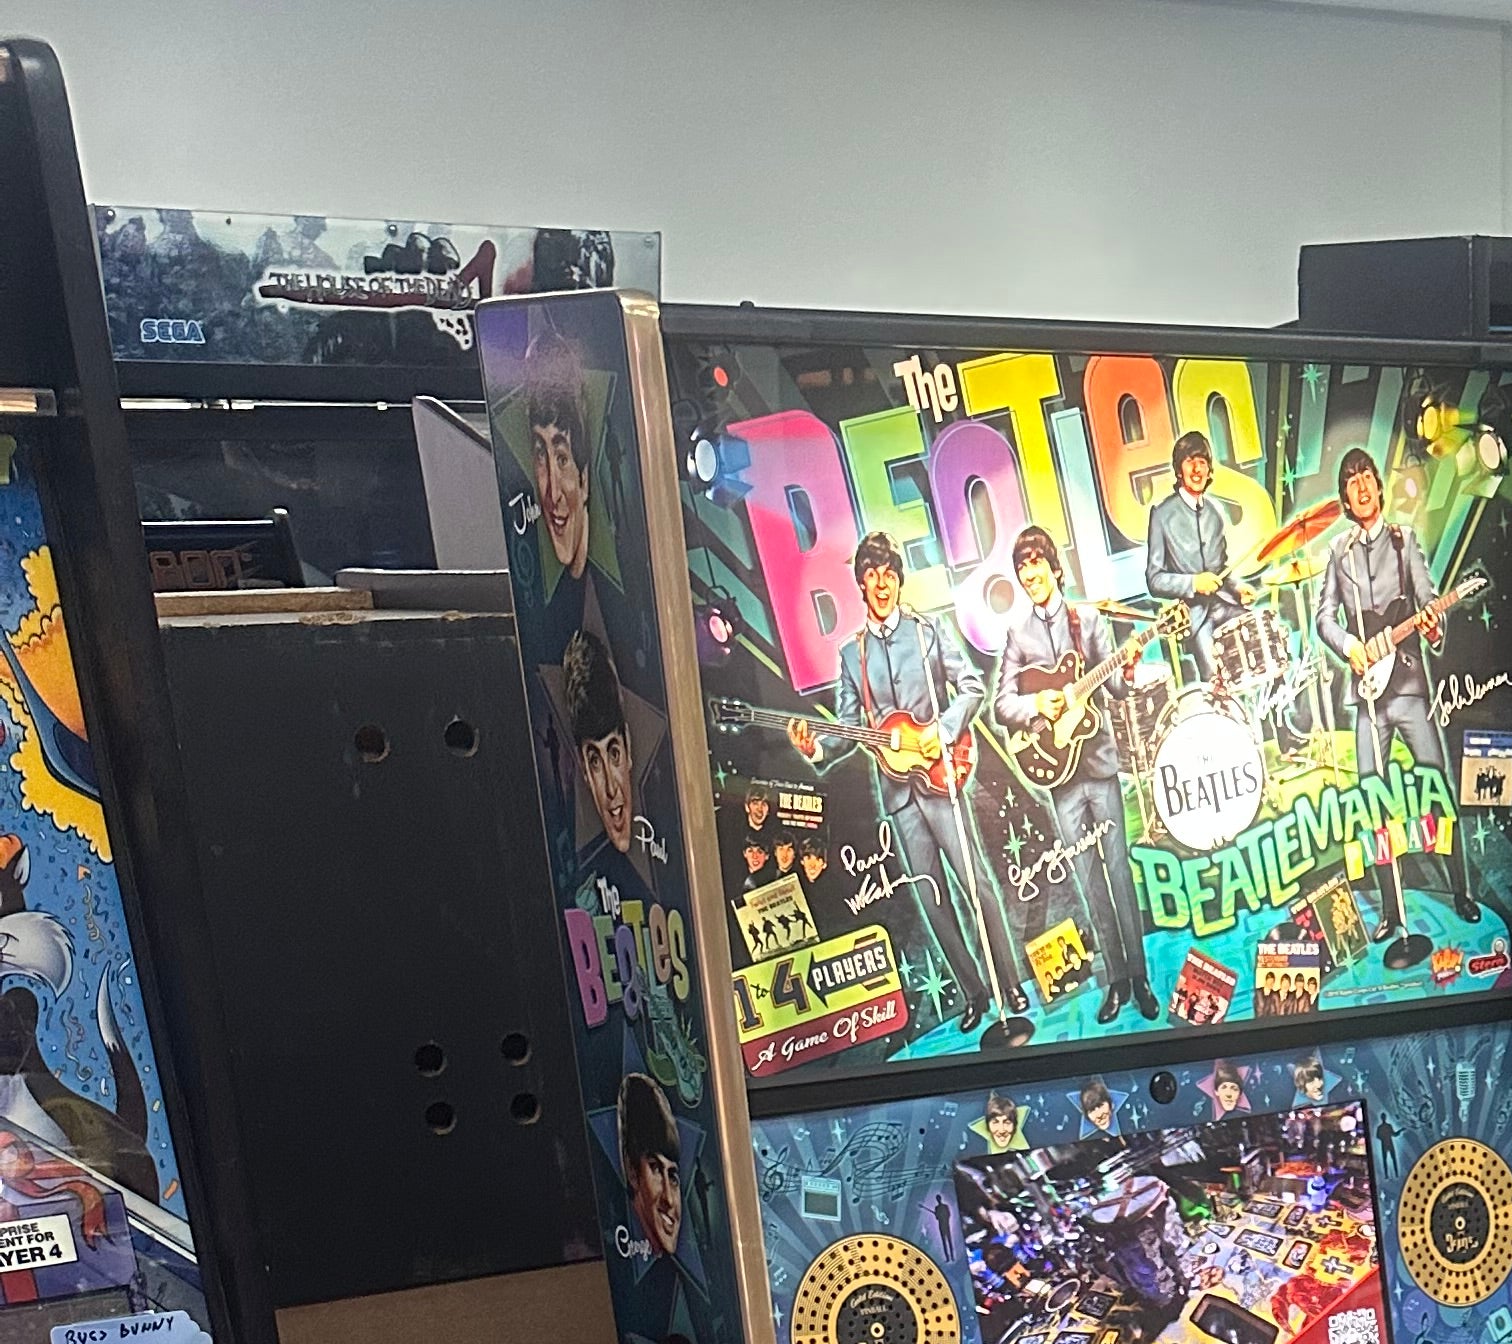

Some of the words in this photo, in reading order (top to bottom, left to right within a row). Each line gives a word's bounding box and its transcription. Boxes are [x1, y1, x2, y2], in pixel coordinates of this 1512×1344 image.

[270, 272, 303, 291] THE
[305, 272, 367, 302] HOUSE
[368, 276, 396, 297] OF
[141, 318, 205, 344] SEGA
[895, 354, 958, 424] The
[727, 352, 1278, 696] BEATLES
[1160, 761, 1259, 818] BEATLES
[1131, 761, 1458, 939] BEATLEMANIA
[597, 876, 621, 916] The
[564, 900, 690, 1029] BEATLES
[1257, 943, 1277, 956] THE
[1277, 943, 1320, 956] BEATLES
[732, 974, 765, 1034] 1
[750, 983, 770, 1000] to
[769, 957, 812, 1016] 4
[811, 947, 888, 991] PLAYERS
[751, 1042, 777, 1071] A
[781, 1031, 829, 1062] Game
[832, 1011, 860, 1043] Of
[861, 1000, 898, 1028] Skill
[27, 1231, 55, 1244] FOR
[49, 1243, 63, 1259] 4
[119, 1316, 174, 1338] BUNNY
